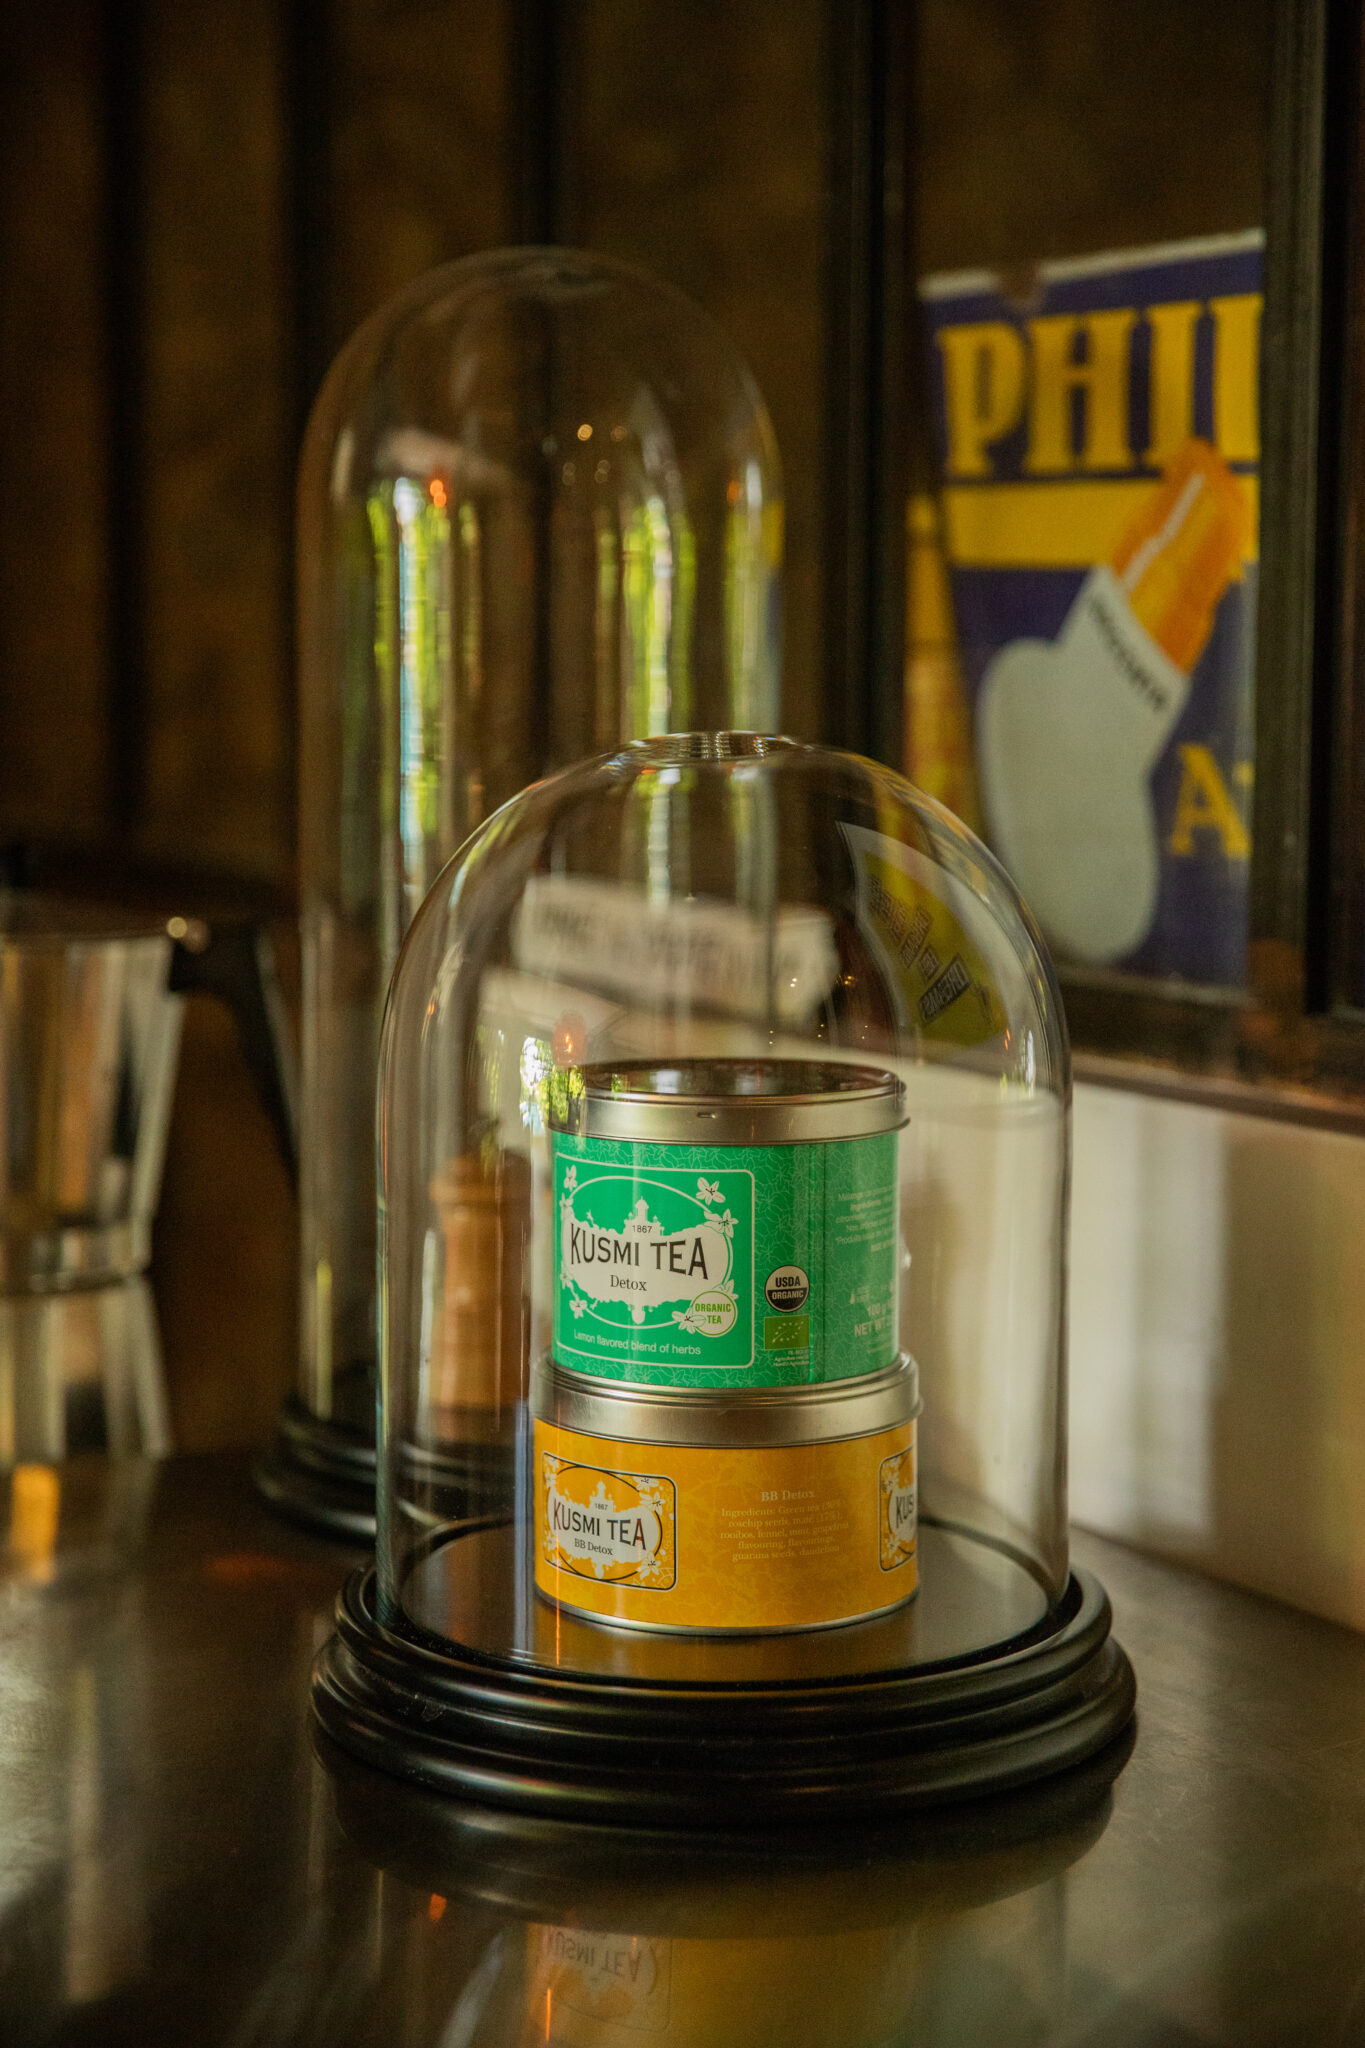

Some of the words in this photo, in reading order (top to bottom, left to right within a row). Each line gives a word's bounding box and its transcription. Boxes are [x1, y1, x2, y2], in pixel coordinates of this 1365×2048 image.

[632, 1224, 653, 1234] 1867
[570, 1222, 640, 1266] KUSMI
[650, 1237, 709, 1281] TEA
[610, 1274, 647, 1291] Detox
[775, 1276, 801, 1288] USDA
[772, 1290, 804, 1300] ORGANIC
[695, 1303, 732, 1313] ORGANIC
[706, 1315, 722, 1324] TEA
[573, 1329, 596, 1343] Lemon
[596, 1335, 629, 1350] flavored
[630, 1340, 657, 1353] blend
[659, 1344, 670, 1353] of
[672, 1344, 702, 1355] herbs
[760, 1490, 778, 1502] BB
[782, 1489, 816, 1500] Detox
[553, 1498, 600, 1536] KUSMI
[606, 1518, 647, 1551] TEA
[574, 1538, 586, 1549] BB
[587, 1542, 613, 1556] Detox
